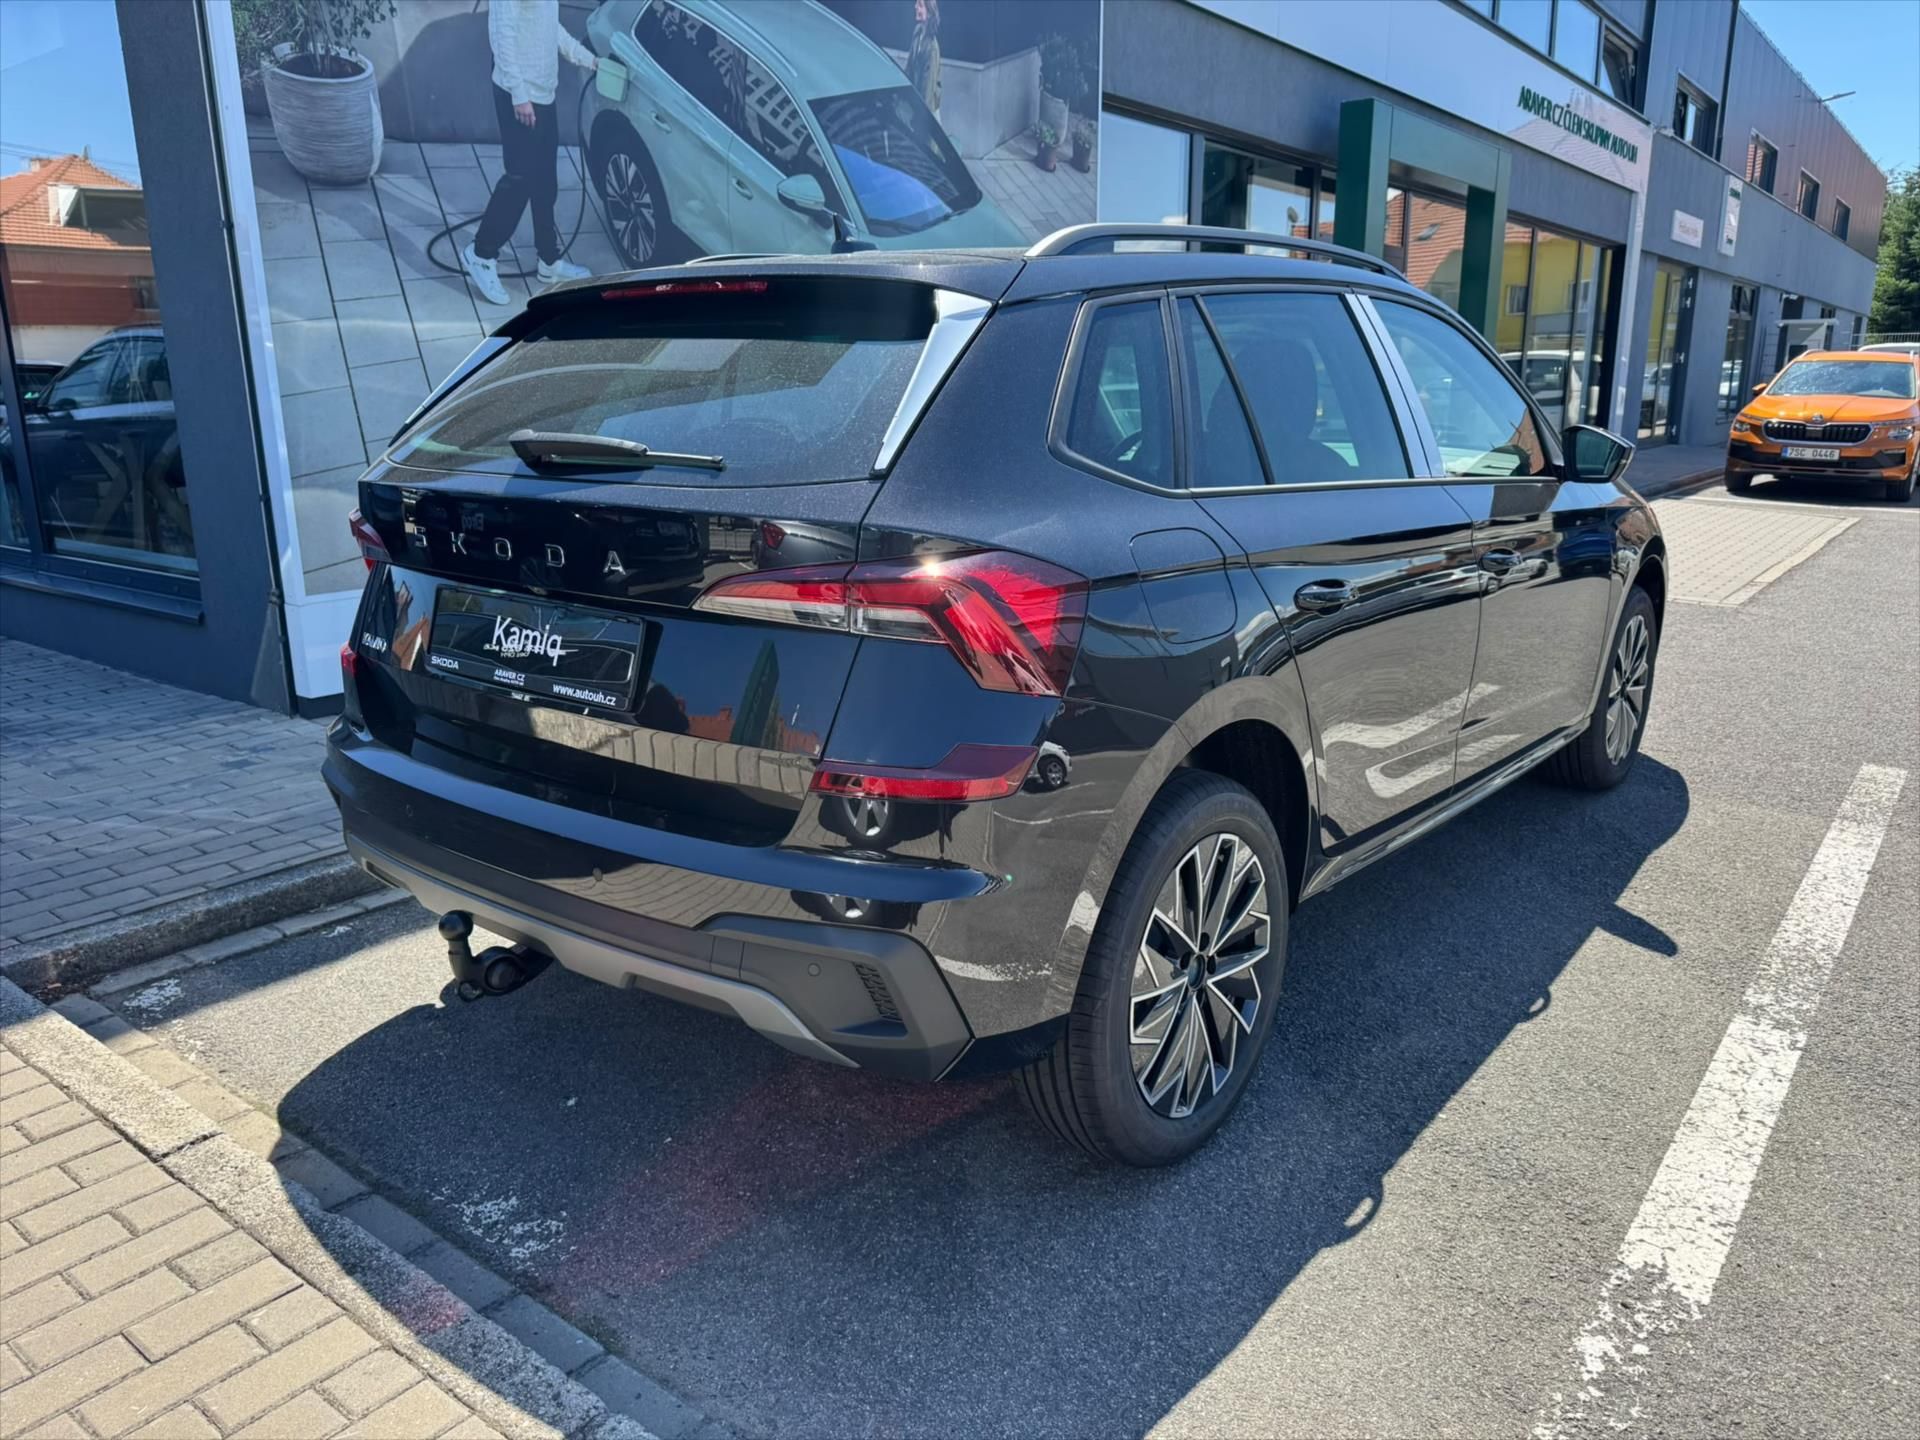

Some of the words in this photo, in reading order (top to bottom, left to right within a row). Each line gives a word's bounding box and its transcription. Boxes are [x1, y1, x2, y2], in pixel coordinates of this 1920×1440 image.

[1517, 85, 1552, 122] ARAVER
[1552, 103, 1564, 128] CZ
[1563, 103, 1584, 137] ČLEN
[1582, 118, 1612, 151] SKUPINY
[492, 615, 563, 667] Kamiq
[494, 668, 517, 681] ARAVER
[516, 673, 526, 682] CZ
[552, 684, 617, 706] www.autouh.cz
